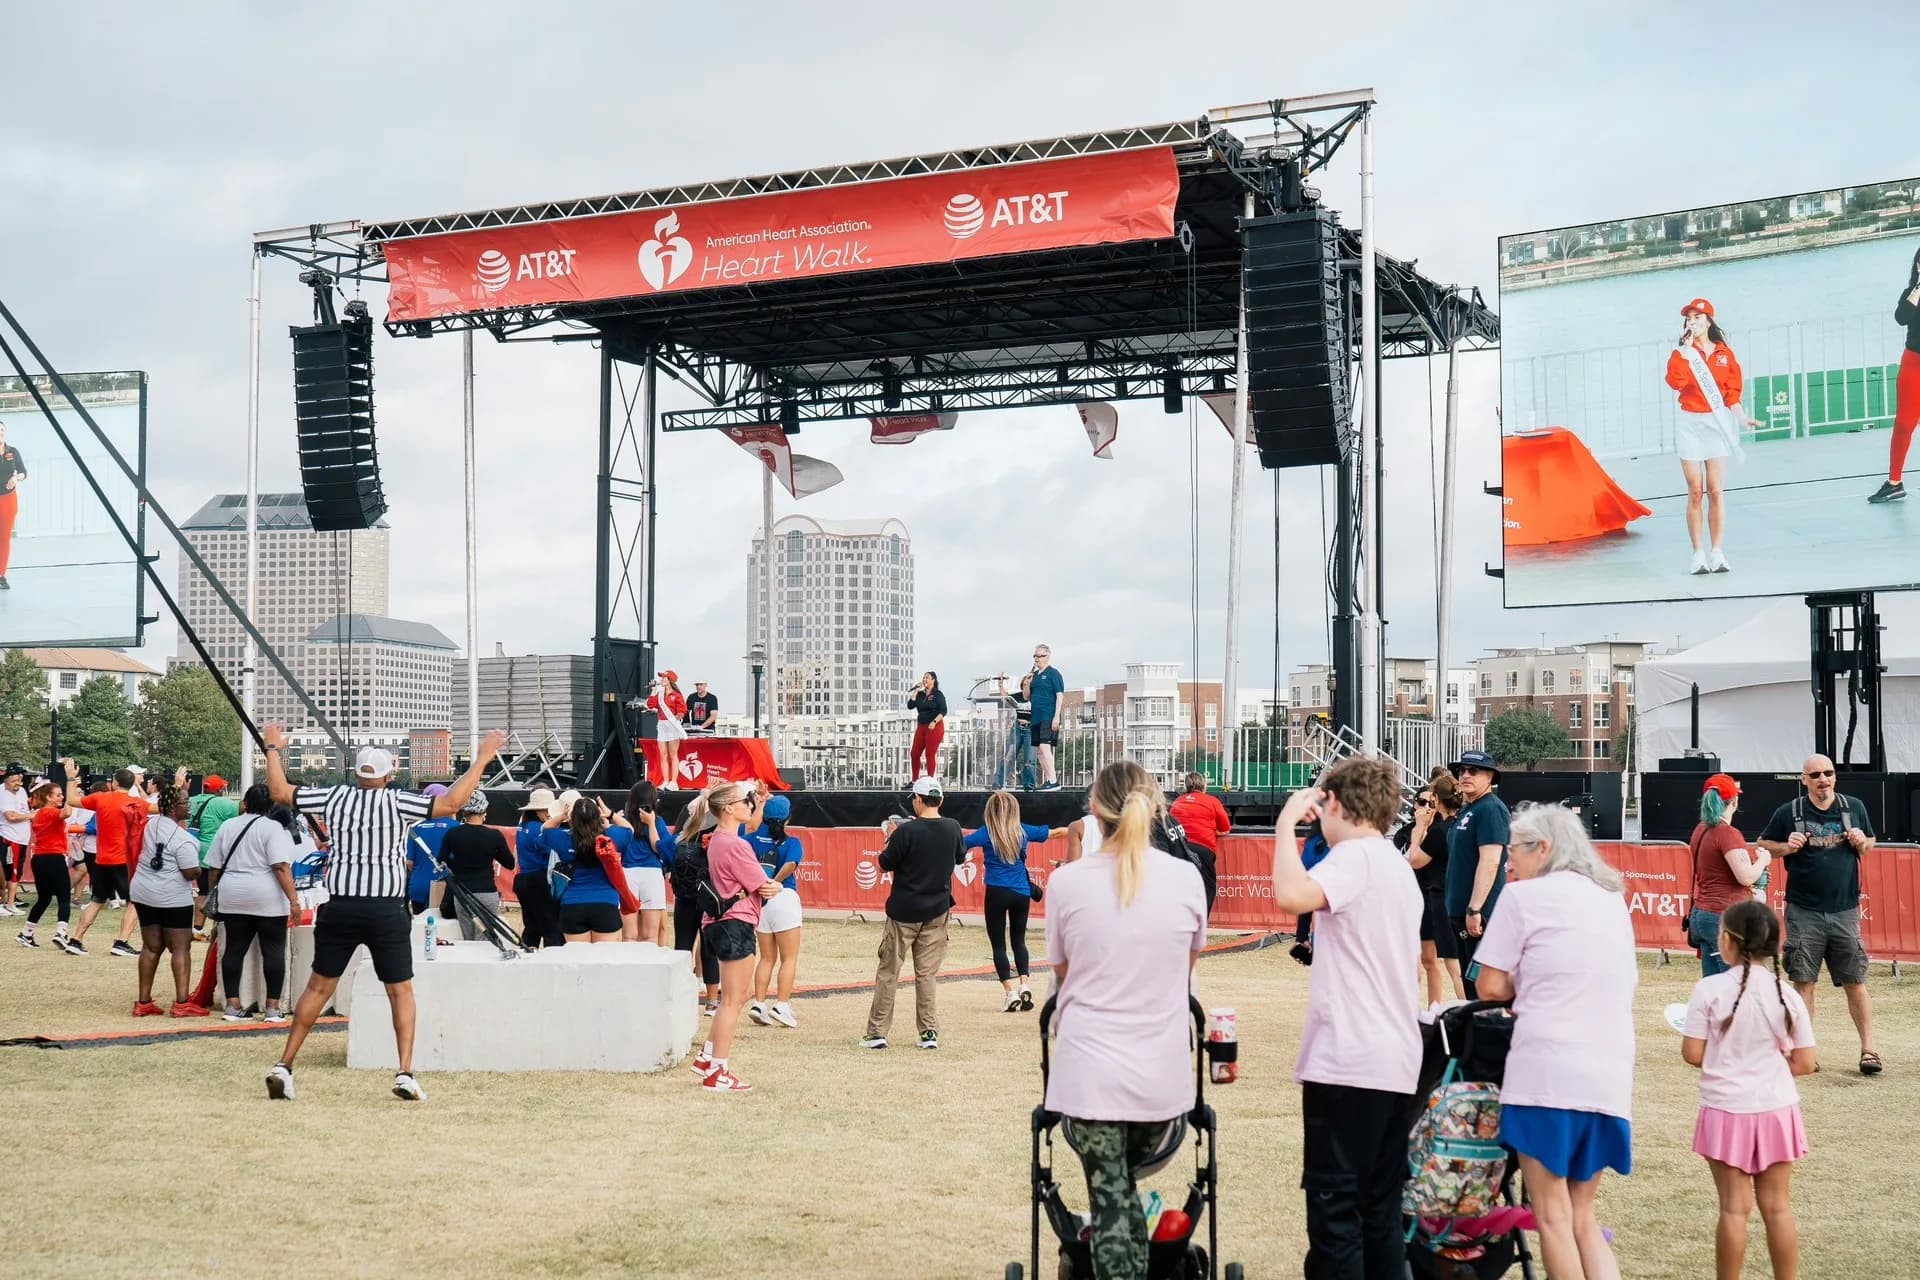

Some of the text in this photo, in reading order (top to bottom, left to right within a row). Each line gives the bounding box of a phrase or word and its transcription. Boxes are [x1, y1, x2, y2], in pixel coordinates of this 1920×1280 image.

[990, 191, 1069, 228] AT&T
[706, 232, 760, 248] American
[763, 227, 797, 241] Heart
[516, 249, 577, 281] AT&T
[701, 250, 785, 282] Heart
[1625, 871, 1665, 880] Sponsored
[1666, 872, 1676, 882] by
[1216, 884, 1244, 898] eart
[1628, 892, 1689, 917] AT&T
